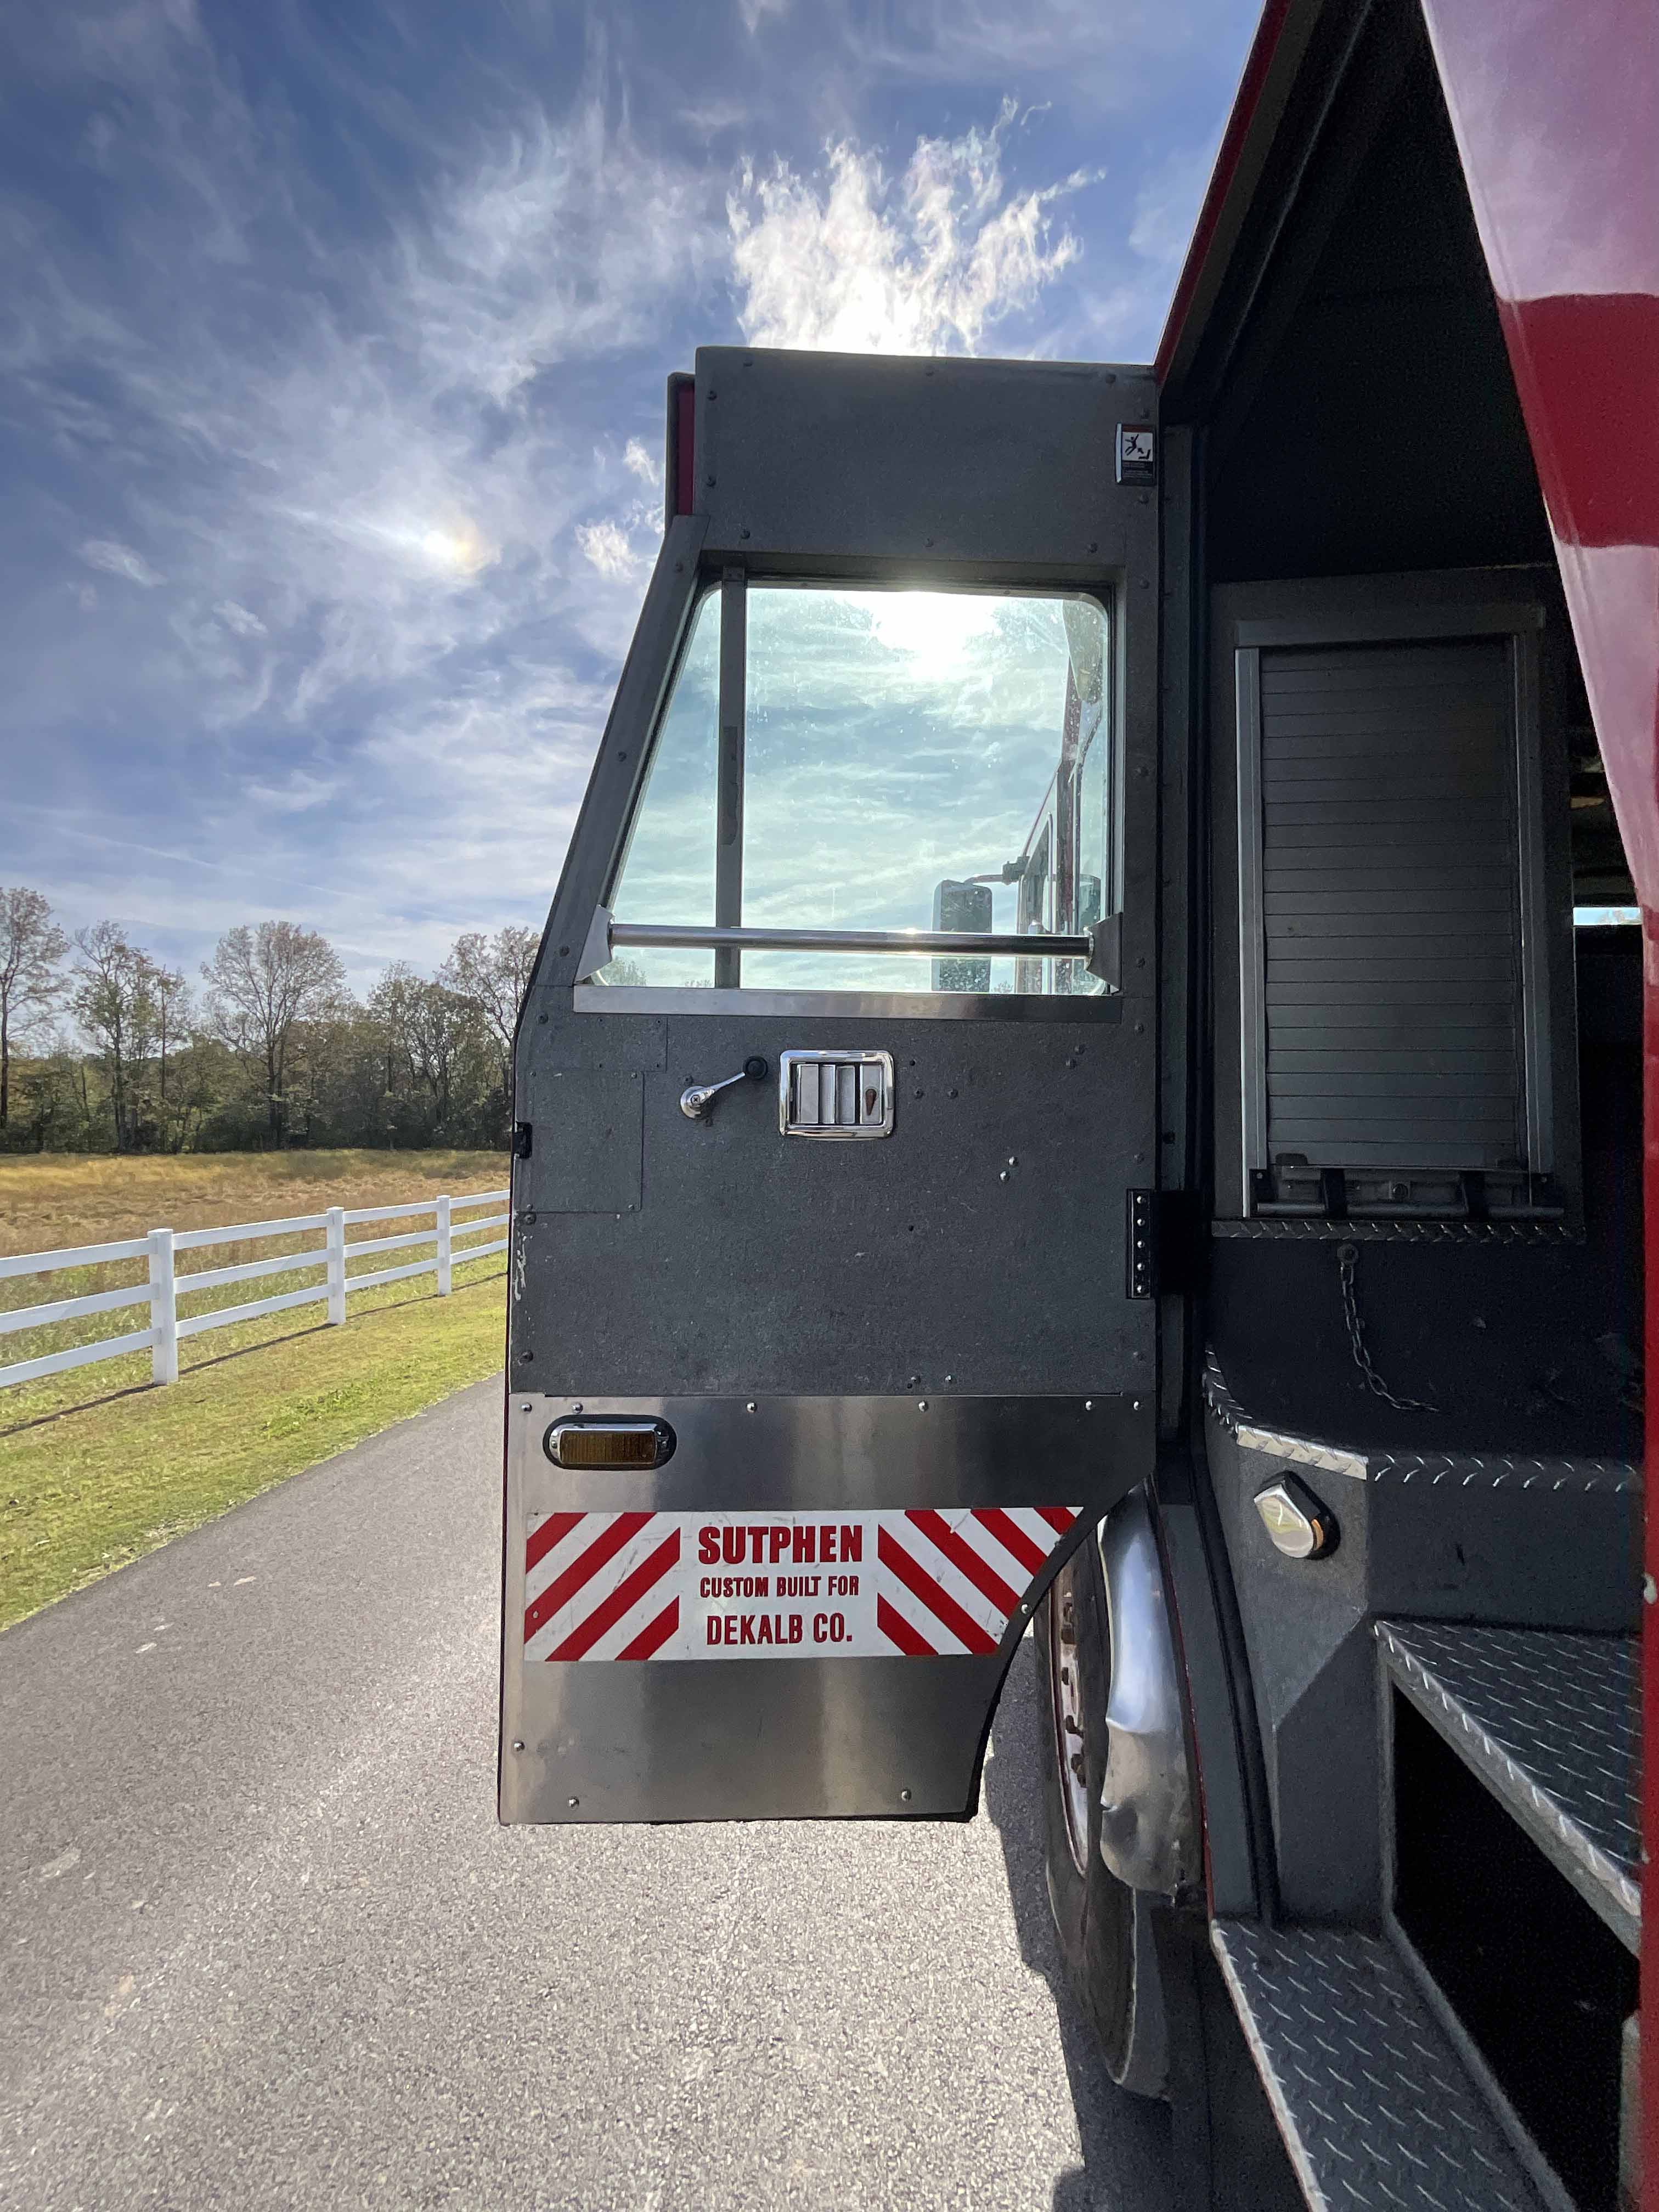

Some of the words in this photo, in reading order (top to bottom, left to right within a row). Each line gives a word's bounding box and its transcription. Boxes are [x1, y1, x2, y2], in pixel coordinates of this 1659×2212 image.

[698, 1525, 862, 1565] SUTPHEN
[700, 1577, 769, 1598] CUSTOM
[776, 1576, 821, 1597] BUILT
[828, 1576, 860, 1596] FOR
[707, 1614, 803, 1646] DEKALB
[814, 1612, 853, 1644] CO.
